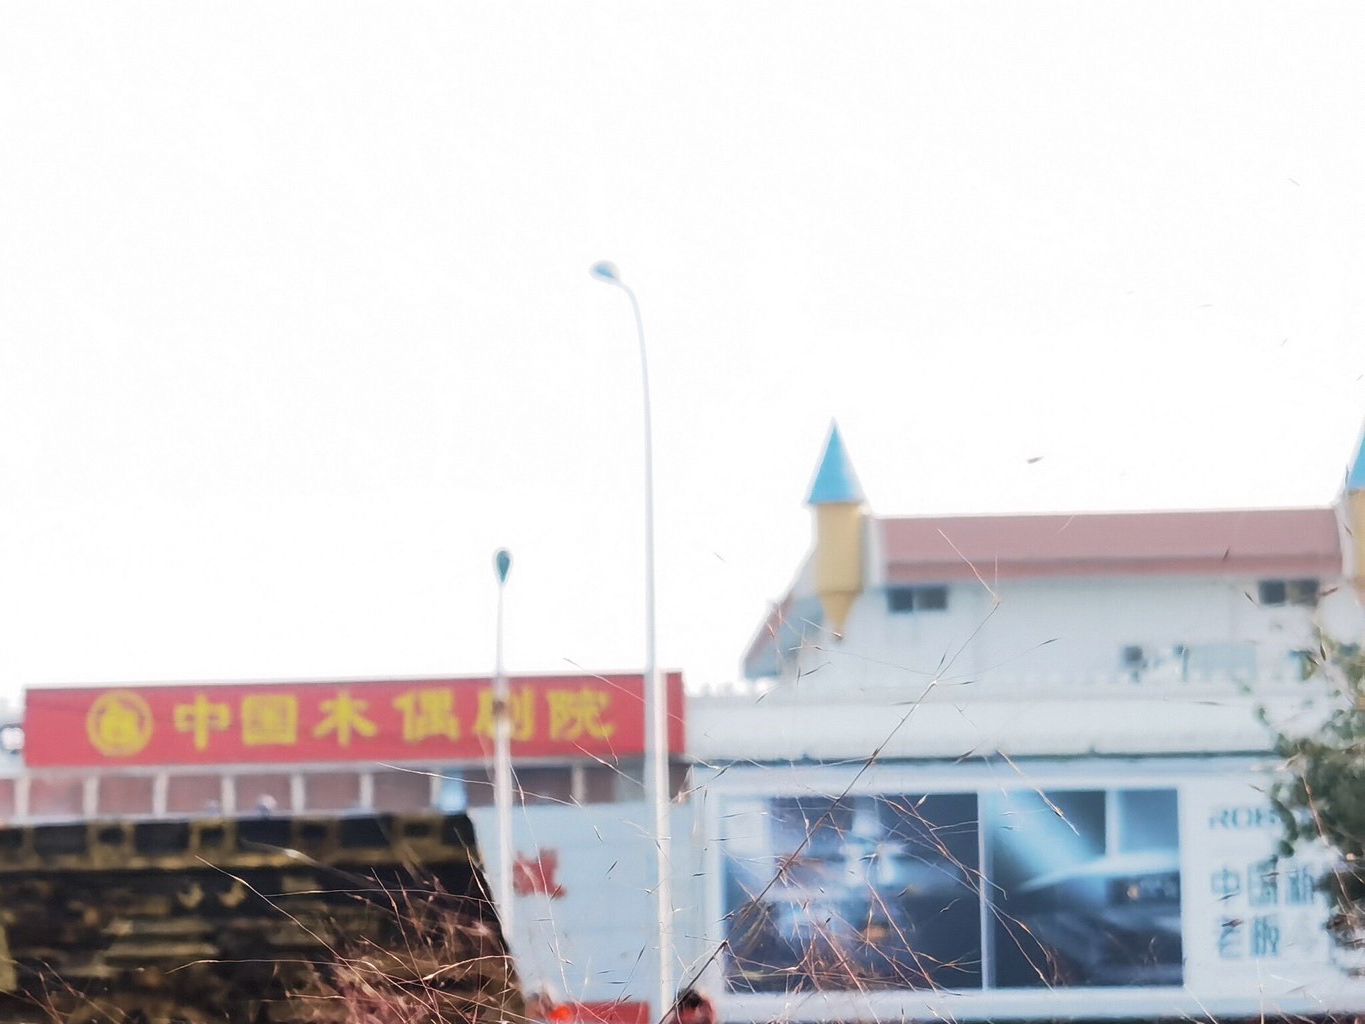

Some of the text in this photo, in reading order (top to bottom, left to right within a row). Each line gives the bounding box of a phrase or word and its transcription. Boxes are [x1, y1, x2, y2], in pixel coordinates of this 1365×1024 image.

[173, 687, 614, 750] 中国木偶剧院
